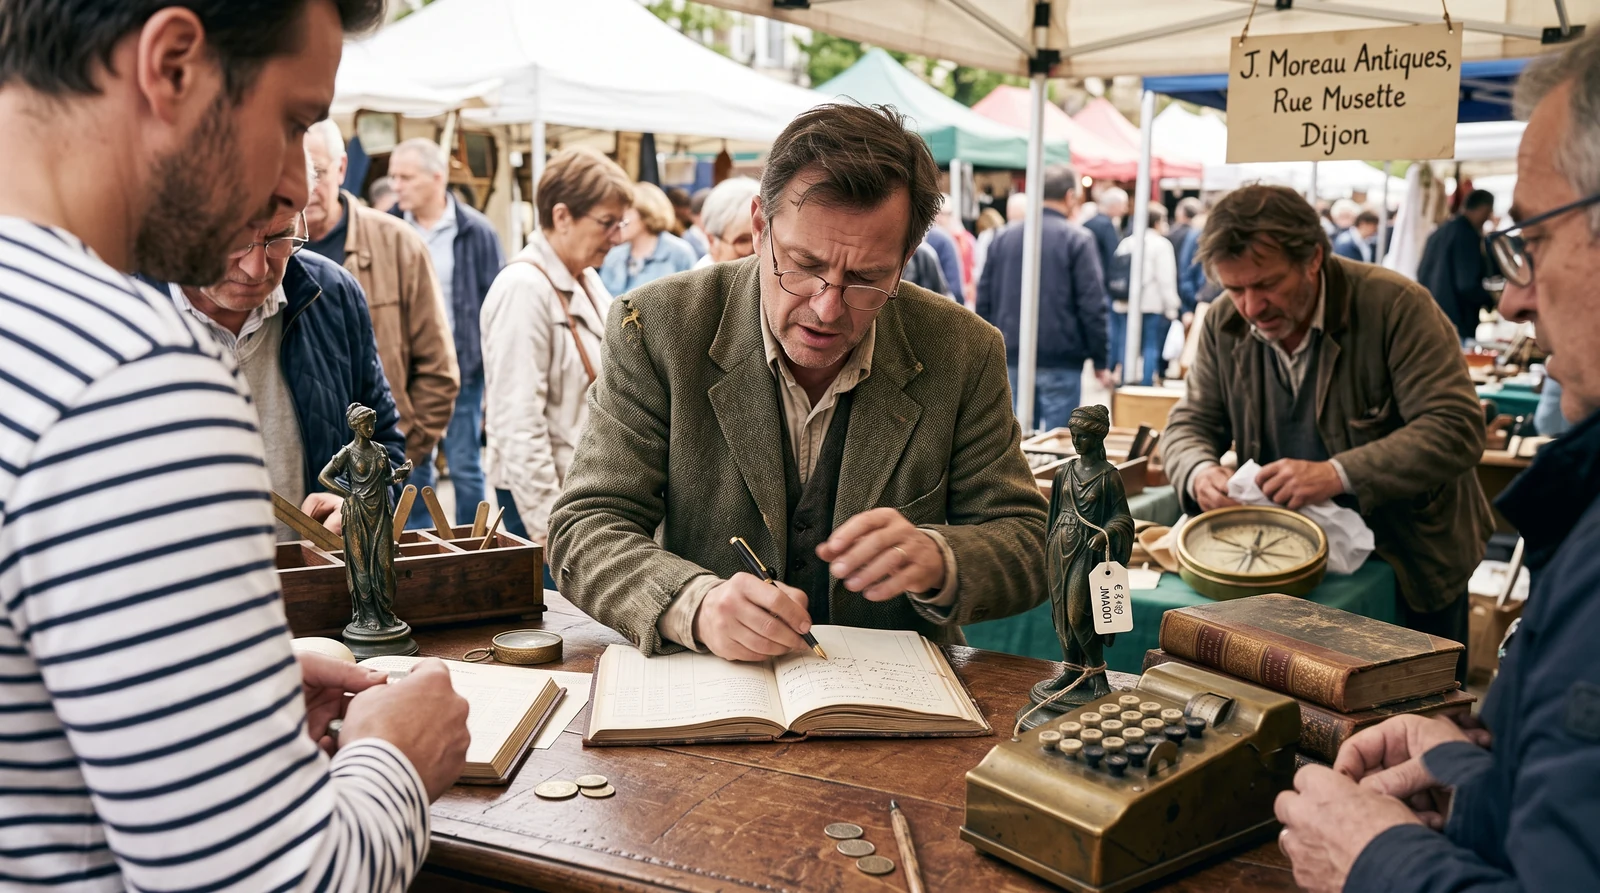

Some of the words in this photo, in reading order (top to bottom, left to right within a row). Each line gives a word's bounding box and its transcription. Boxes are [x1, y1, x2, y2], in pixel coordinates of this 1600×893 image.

[1239, 49, 1261, 79] J.
[1268, 48, 1346, 78] Moreau
[1353, 42, 1453, 80] Antiques,
[1273, 86, 1313, 114] Rue
[1322, 83, 1407, 112] Musette
[1300, 121, 1370, 156] Dijon
[1100, 586, 1112, 624] JMA001
